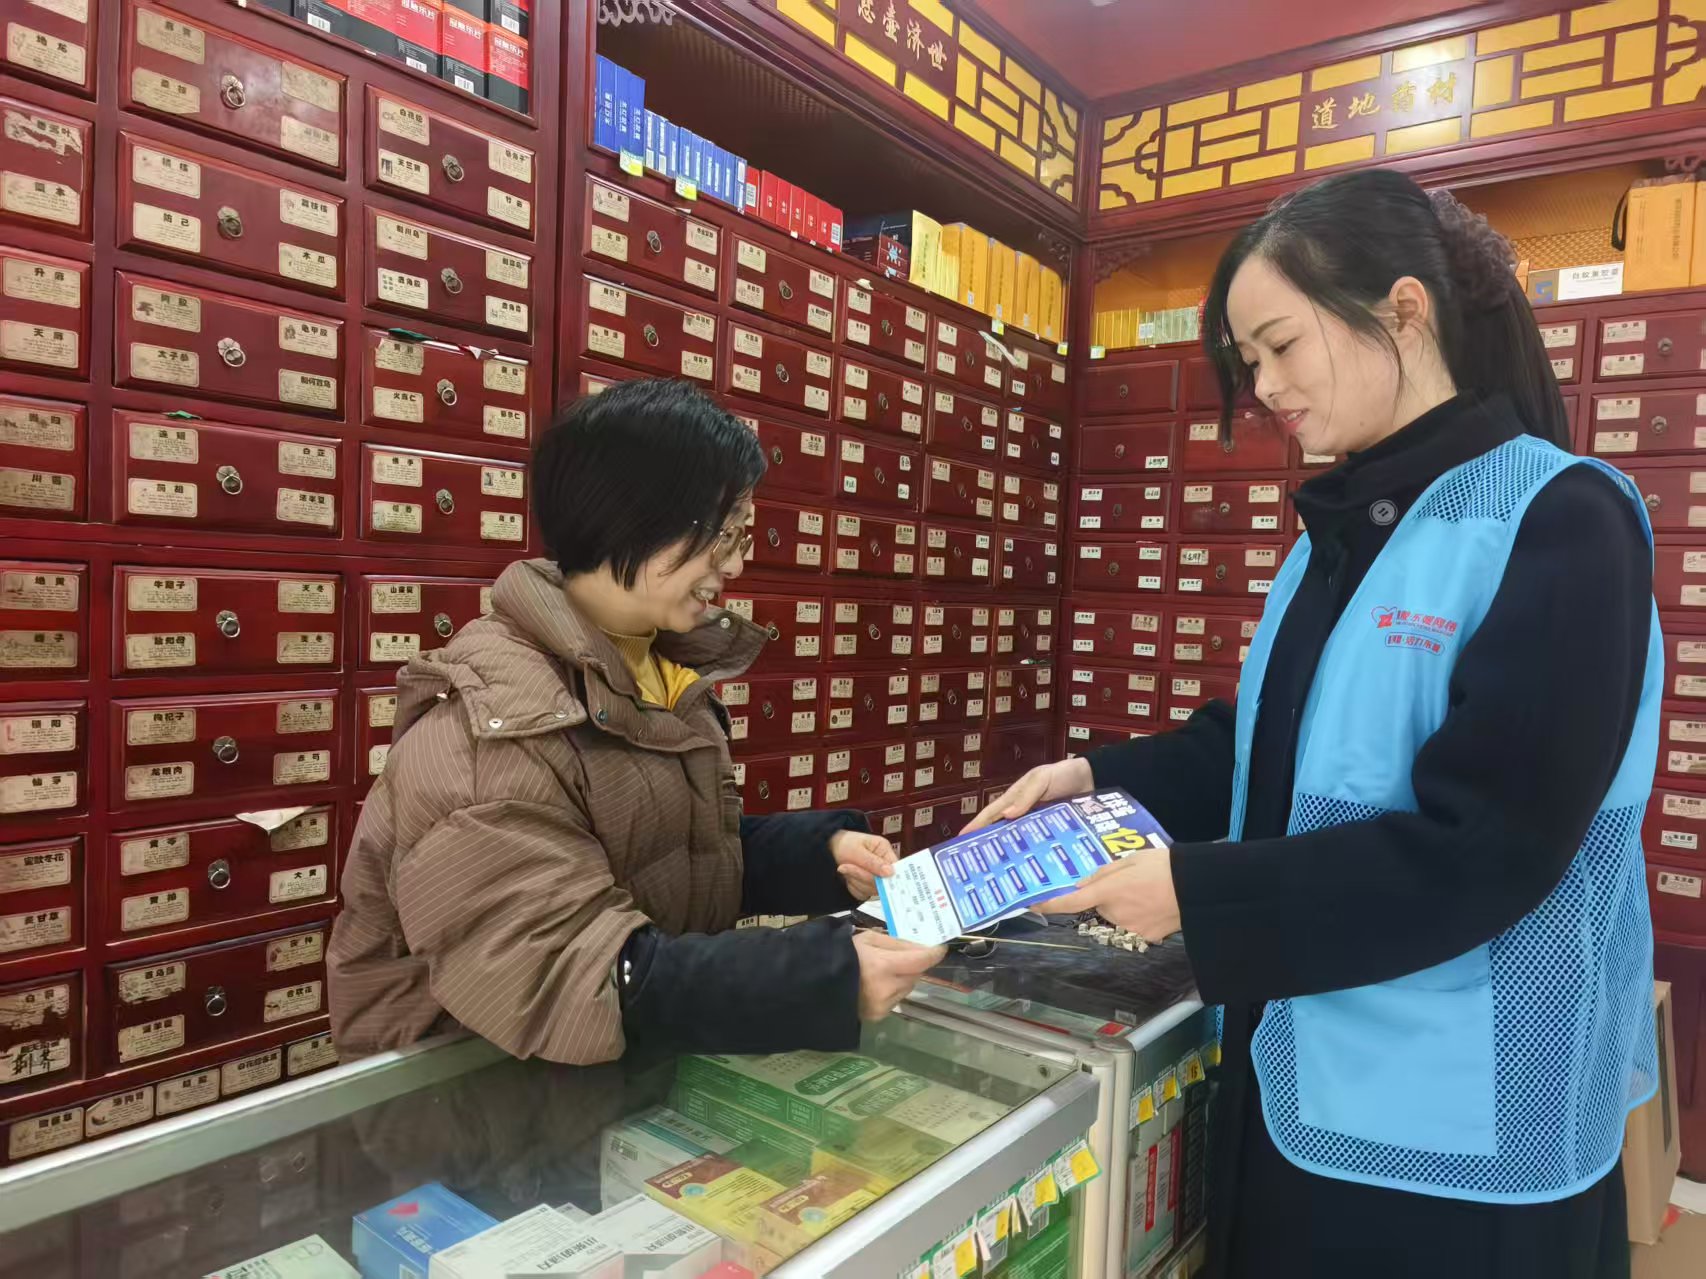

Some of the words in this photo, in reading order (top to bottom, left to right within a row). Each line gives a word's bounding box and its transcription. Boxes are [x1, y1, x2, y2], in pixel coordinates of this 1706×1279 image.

[302, 250, 326, 265] 木瓜
[33, 266, 65, 282] 升麻
[160, 293, 188, 308] 阿胶
[33, 327, 64, 342] 天麻
[301, 323, 328, 337] 龟甲胶
[153, 712, 185, 722] 枸杞子
[150, 766, 183, 777] 龙眼肉
[1100, 827, 1147, 853] 12
[294, 868, 318, 879] 大黄
